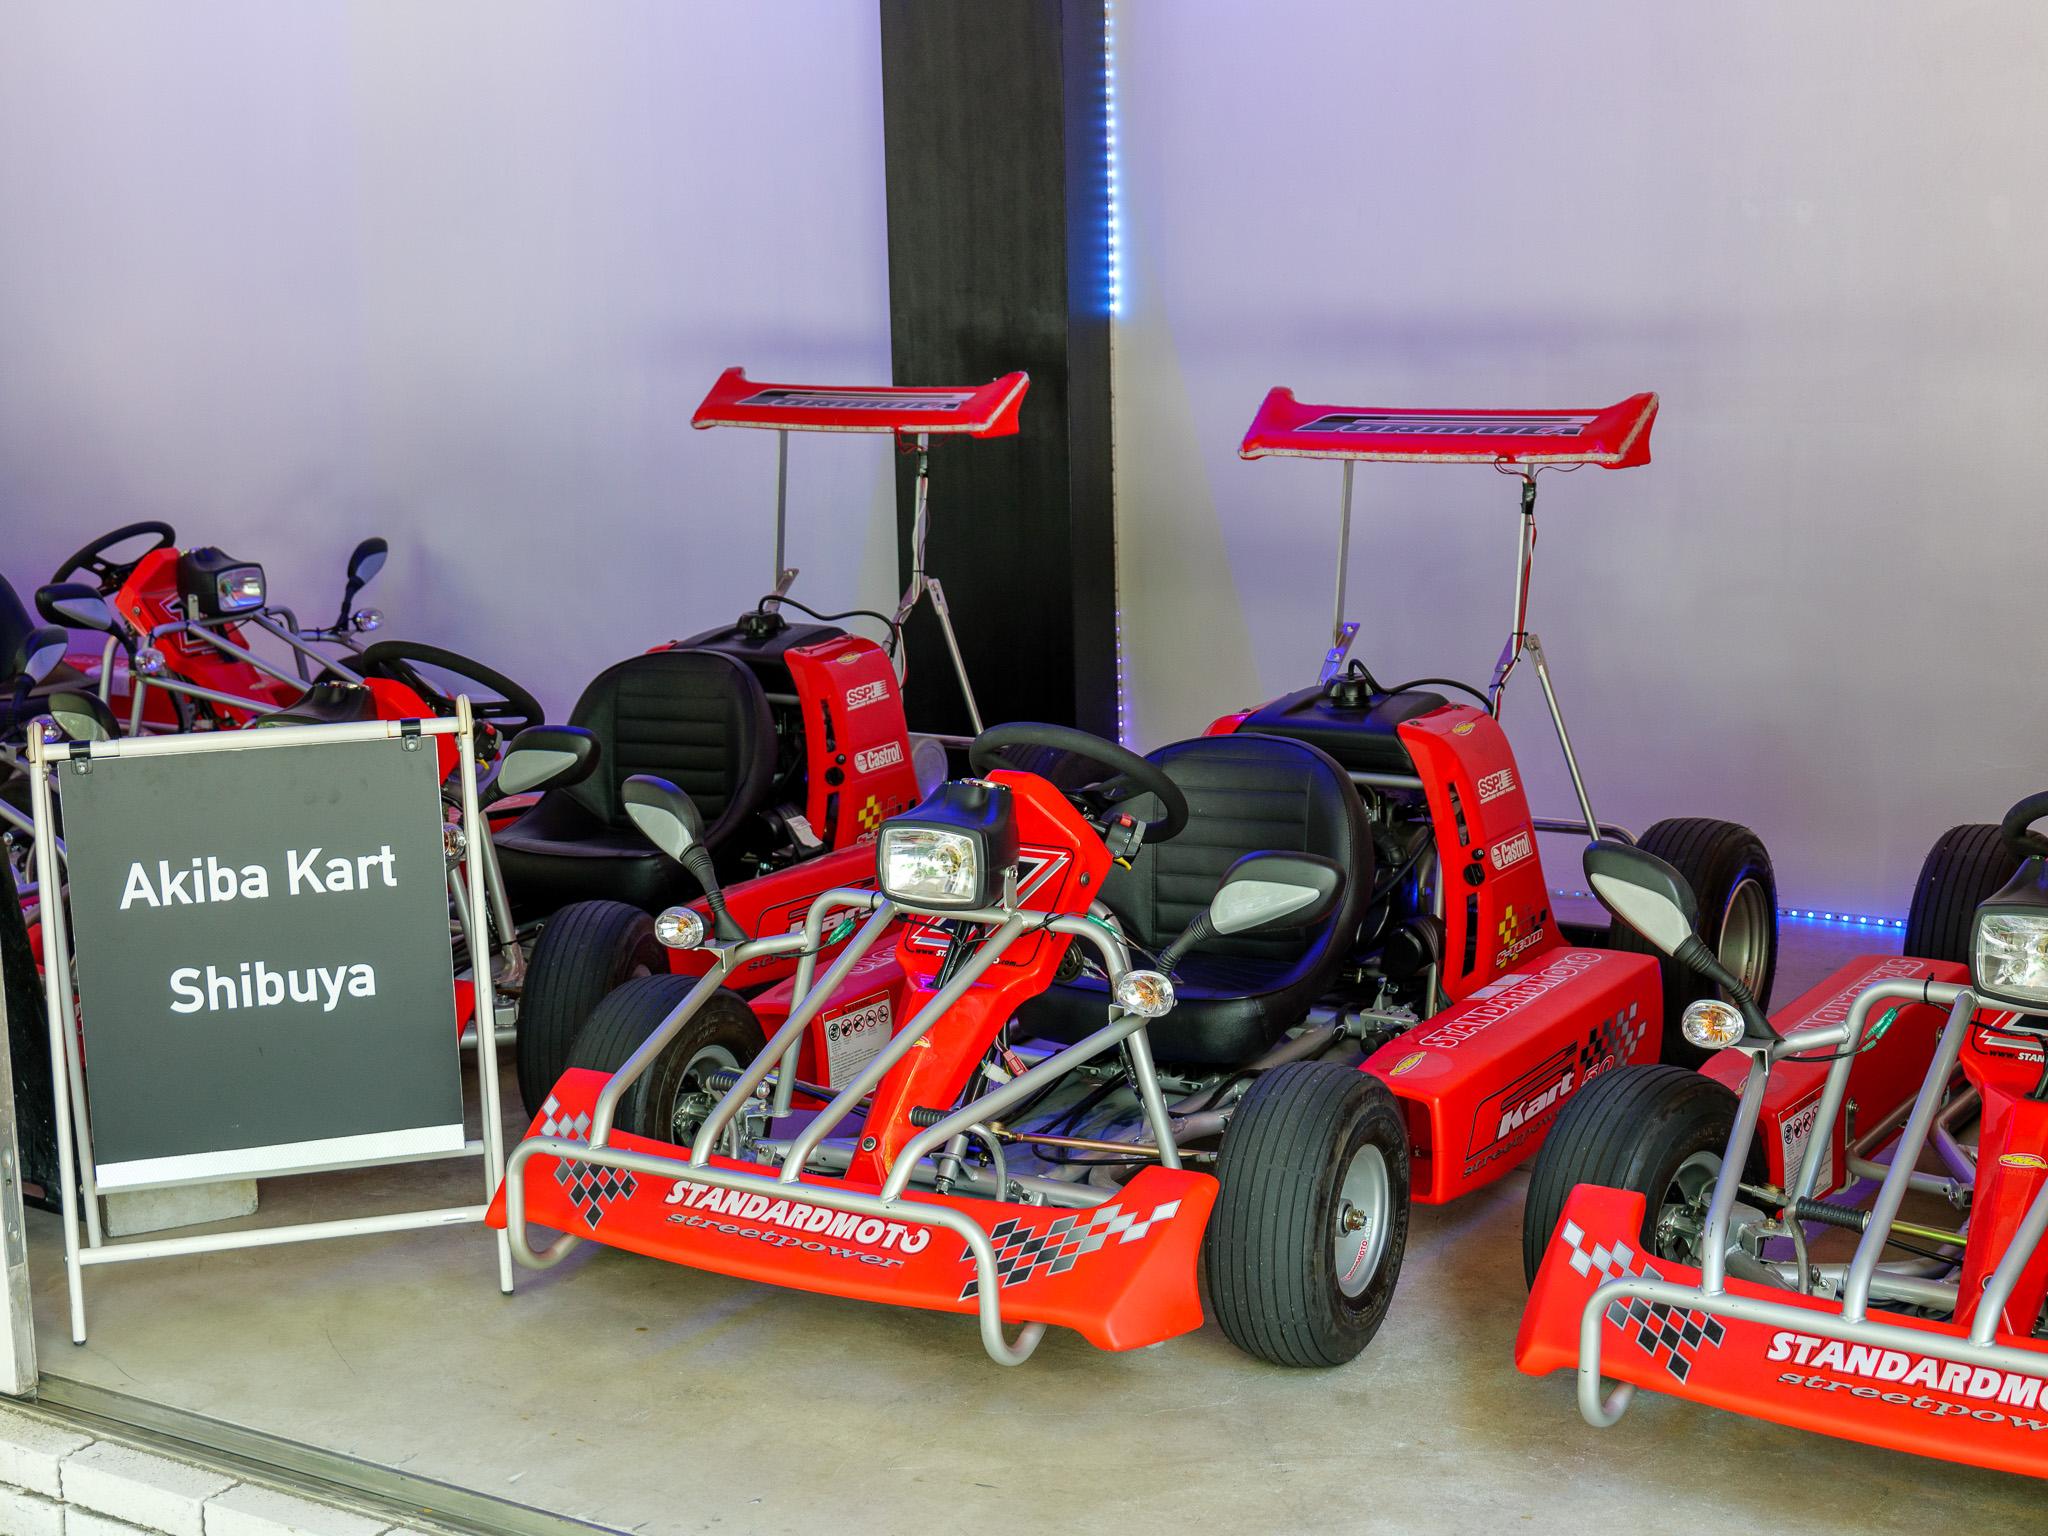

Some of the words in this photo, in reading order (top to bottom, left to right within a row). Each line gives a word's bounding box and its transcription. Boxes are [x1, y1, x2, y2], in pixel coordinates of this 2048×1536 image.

[867, 743, 901, 770] Castrol
[120, 858, 270, 910] Akiba
[286, 845, 398, 895] Kart
[1500, 836, 1530, 866] Castrol
[170, 962, 377, 1013] Shibuya
[1418, 952, 1602, 1048] STANDARDMOTO
[1497, 1071, 1575, 1140] Kart
[664, 1180, 930, 1254] STANDARDMOTO
[666, 1213, 904, 1268] streetpower
[1766, 1331, 2048, 1413] STANDARDM
